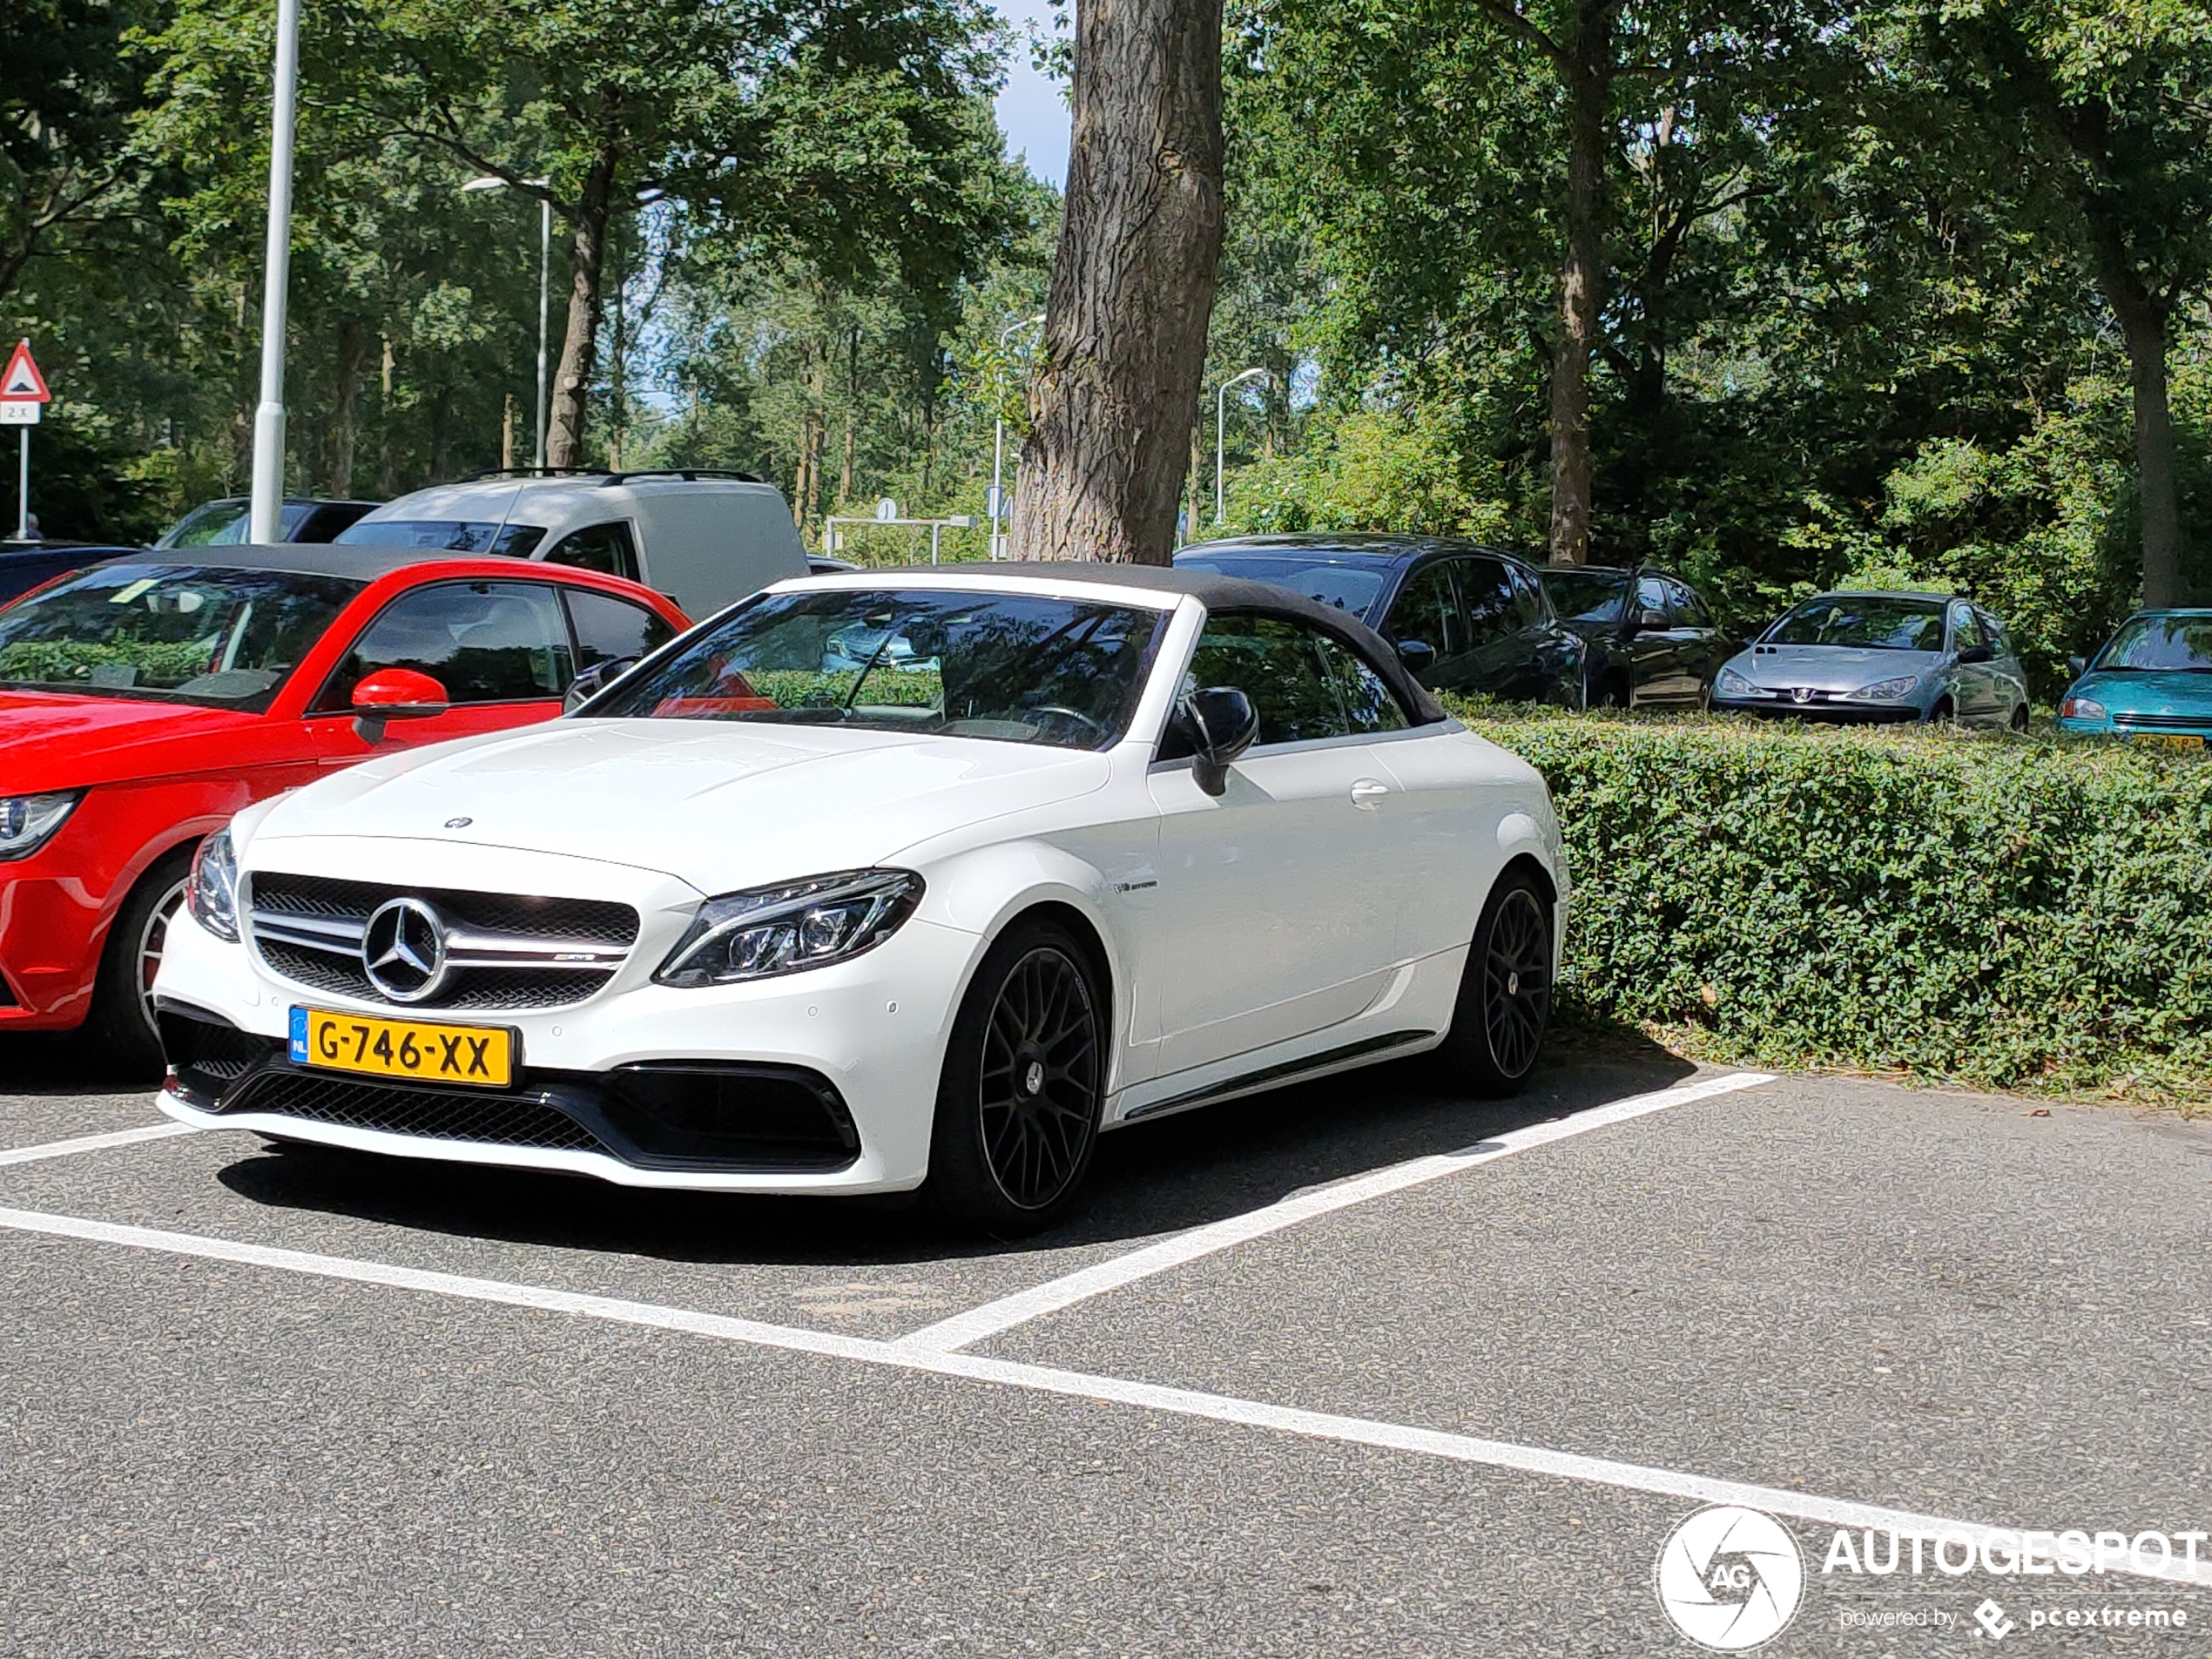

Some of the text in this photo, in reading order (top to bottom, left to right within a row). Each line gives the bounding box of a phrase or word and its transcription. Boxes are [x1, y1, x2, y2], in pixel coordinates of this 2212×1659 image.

[8, 407, 16, 418] 2
[293, 1039, 308, 1055] NL
[319, 1021, 490, 1078] G-746-XX
